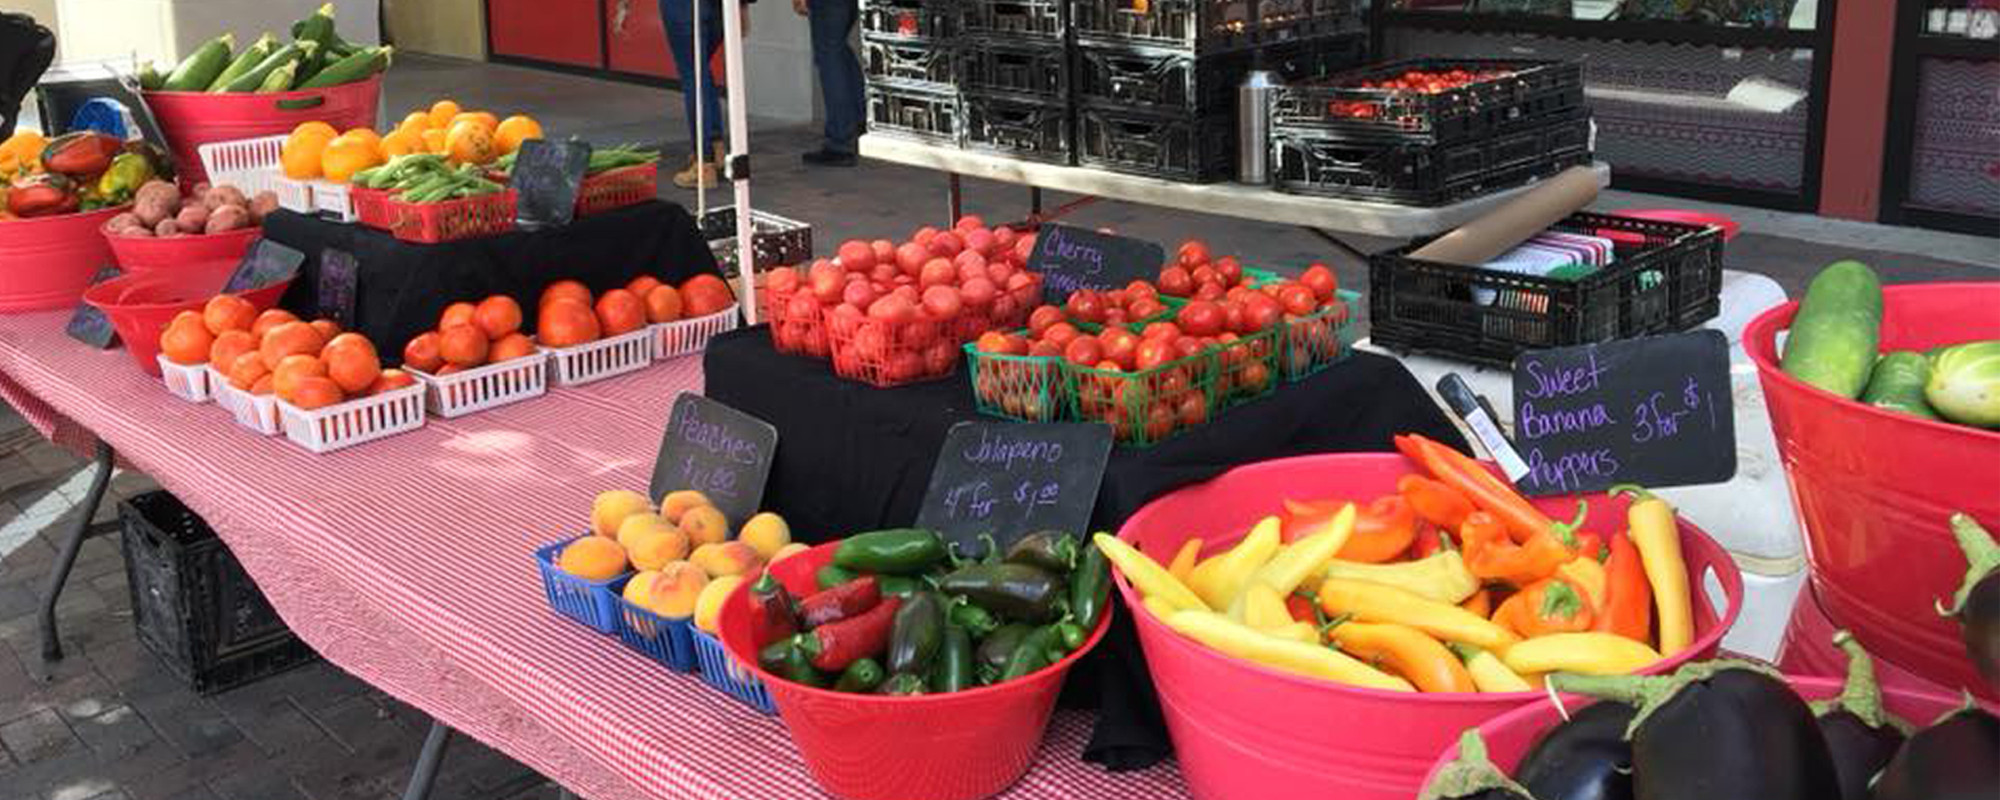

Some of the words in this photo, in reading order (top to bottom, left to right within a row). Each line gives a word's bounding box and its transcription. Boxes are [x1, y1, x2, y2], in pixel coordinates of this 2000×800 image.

[1044, 224, 1102, 274] Cherry
[1525, 353, 1608, 398] Sweet
[680, 401, 758, 464] Peaches
[1521, 401, 1617, 439] Banana
[963, 427, 1063, 470] Jalapeno
[1529, 447, 1620, 491] Peppers
[944, 484, 966, 518] 4
[970, 481, 998, 517] for
